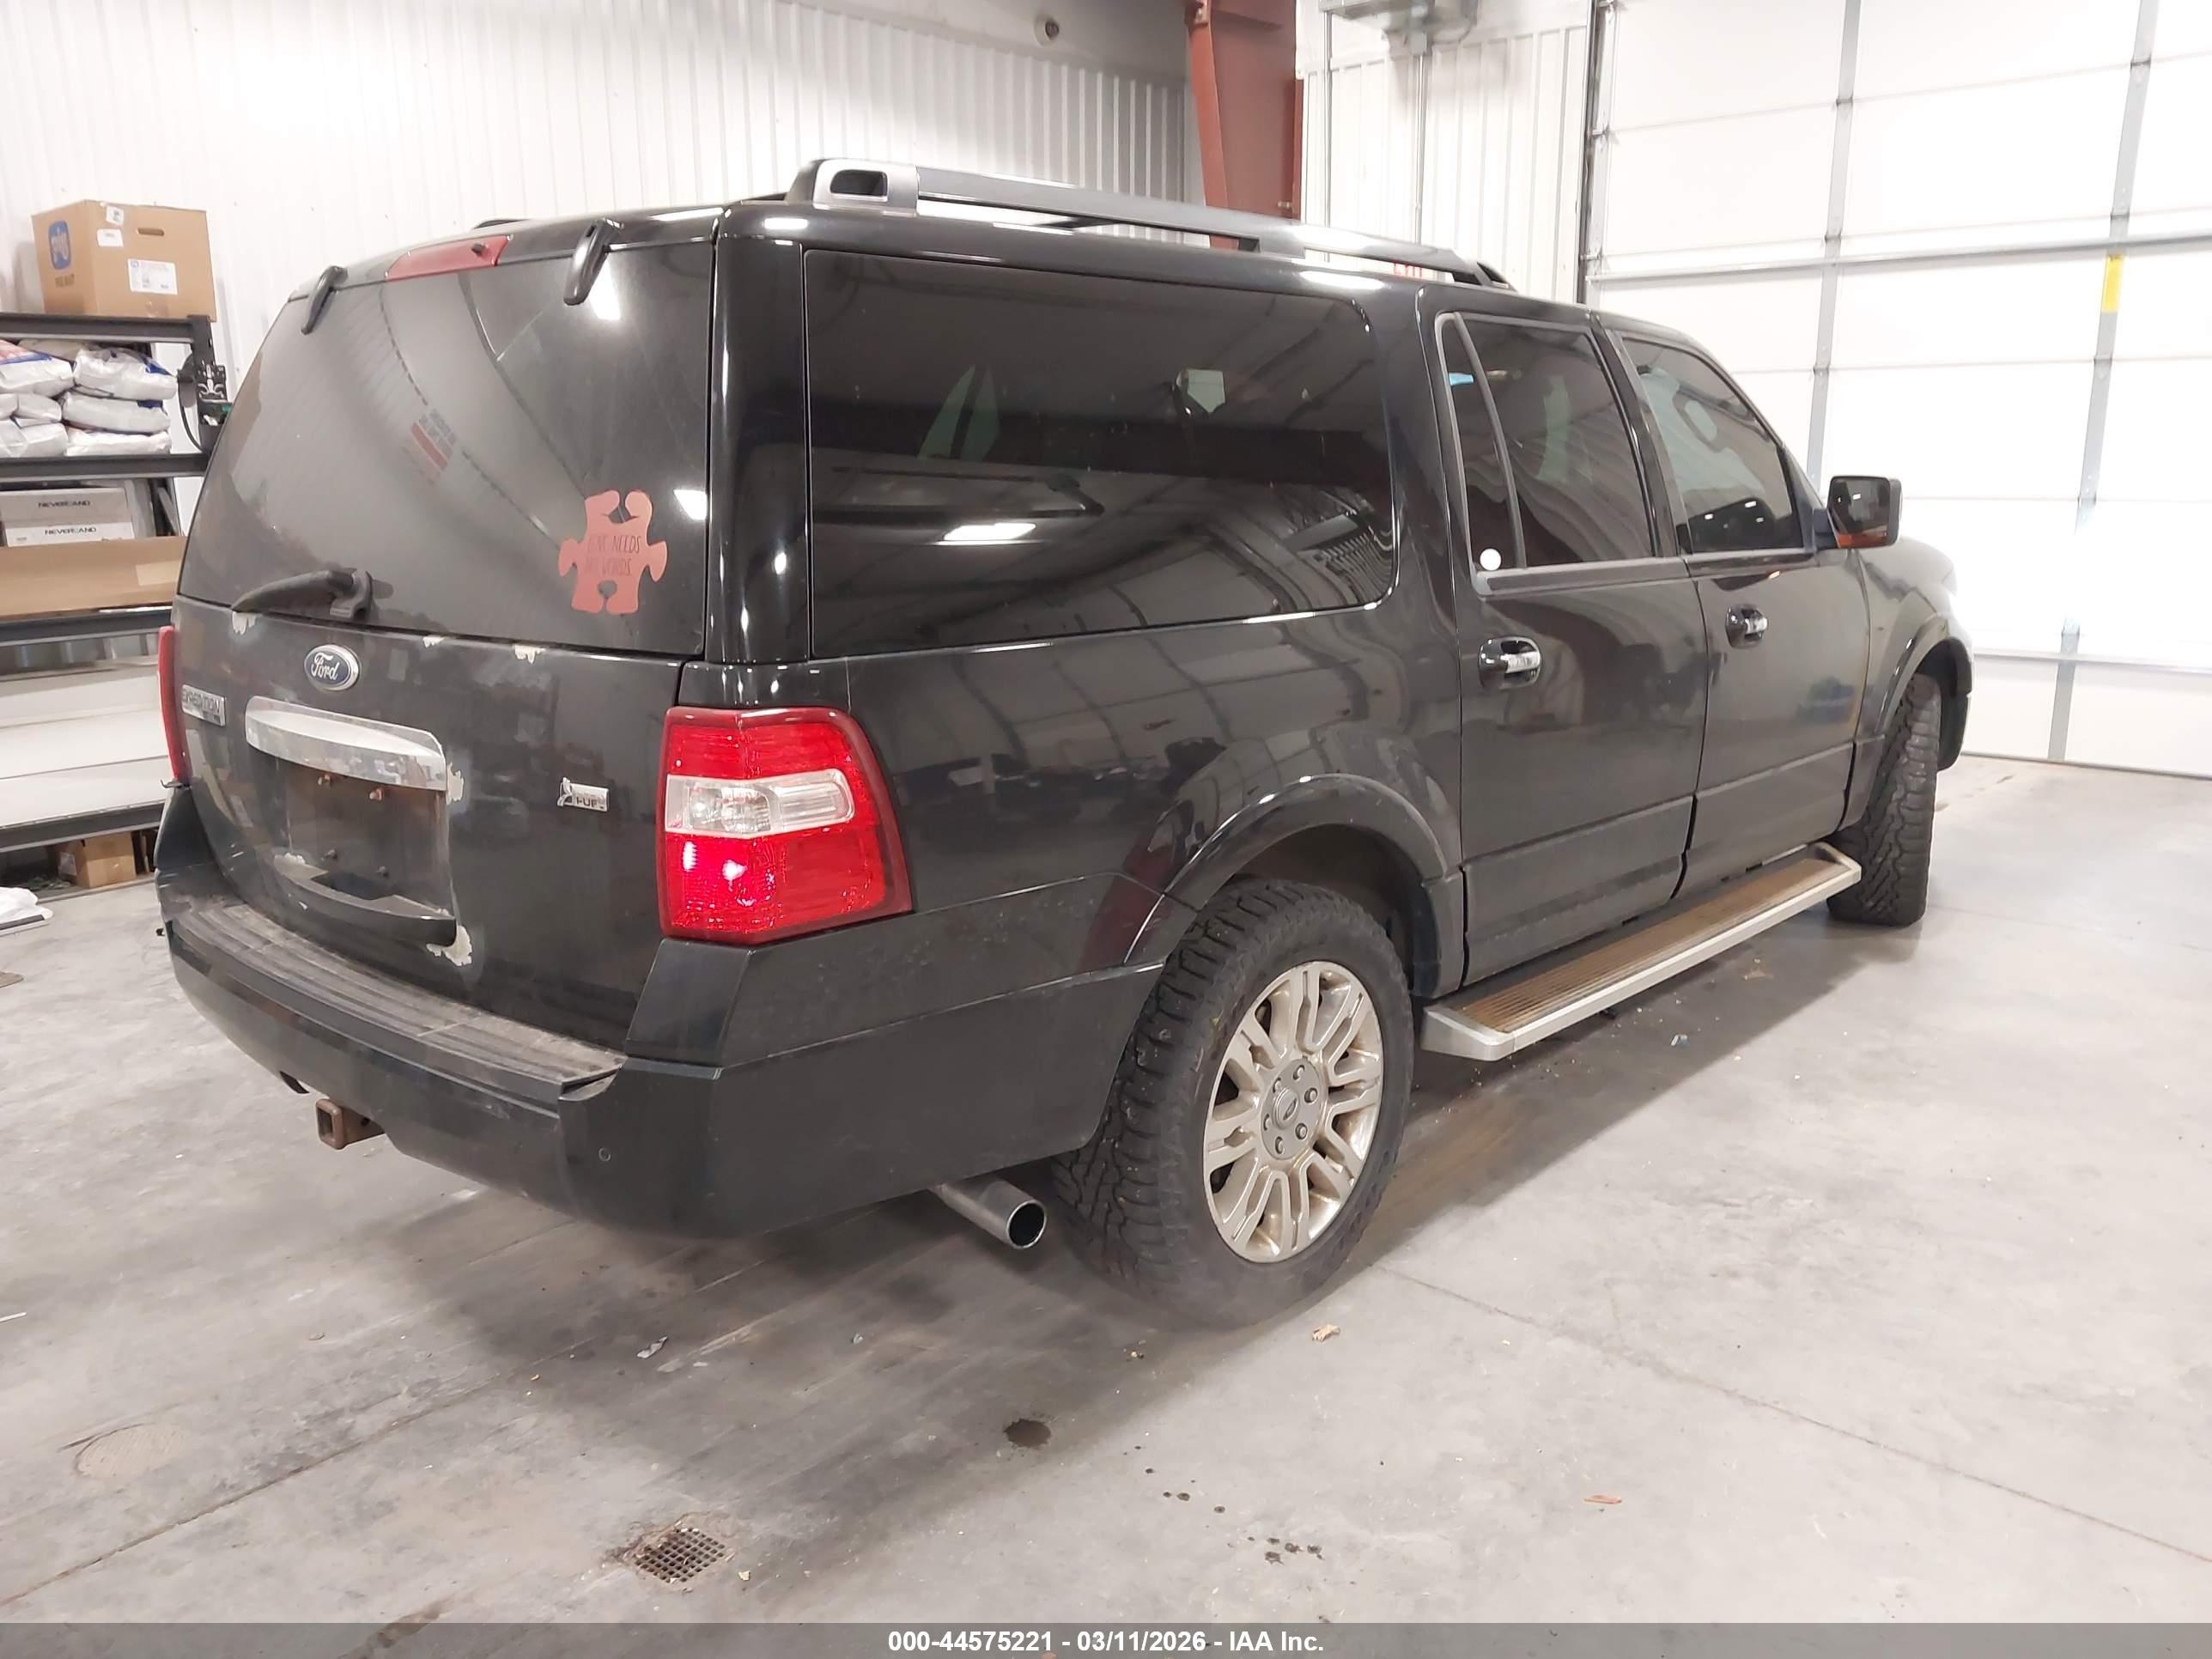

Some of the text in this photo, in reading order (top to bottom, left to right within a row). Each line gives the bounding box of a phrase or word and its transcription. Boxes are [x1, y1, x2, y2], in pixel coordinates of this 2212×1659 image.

[38, 500, 91, 508] NEVERAND
[45, 526, 97, 535] NEVERAND
[311, 652, 340, 681] Ford
